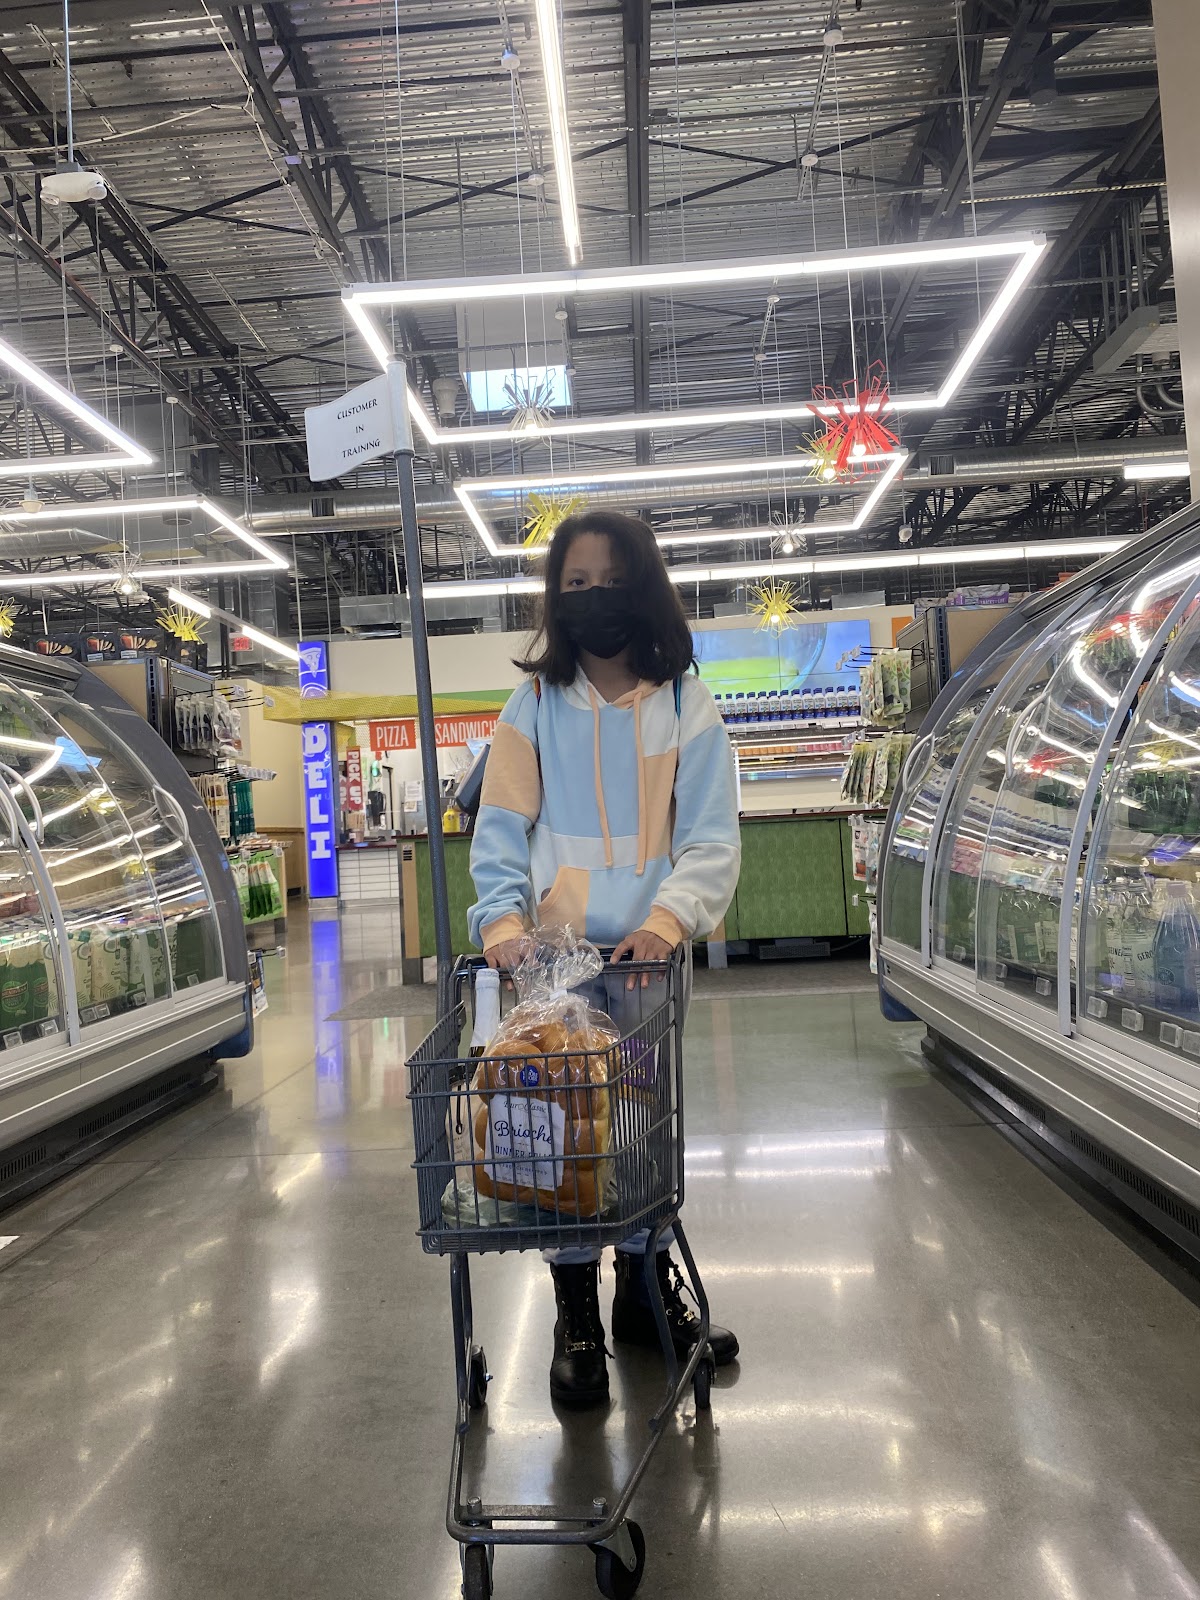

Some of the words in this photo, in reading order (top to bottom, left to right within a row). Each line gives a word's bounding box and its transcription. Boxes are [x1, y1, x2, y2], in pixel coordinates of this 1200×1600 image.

[337, 398, 378, 420] CUSTOMER
[355, 424, 364, 433] IN
[342, 438, 381, 458] TRAINING
[376, 725, 410, 748] PIZZA
[347, 751, 361, 782] PICK
[304, 726, 332, 860] DELI
[349, 785, 362, 805] UP
